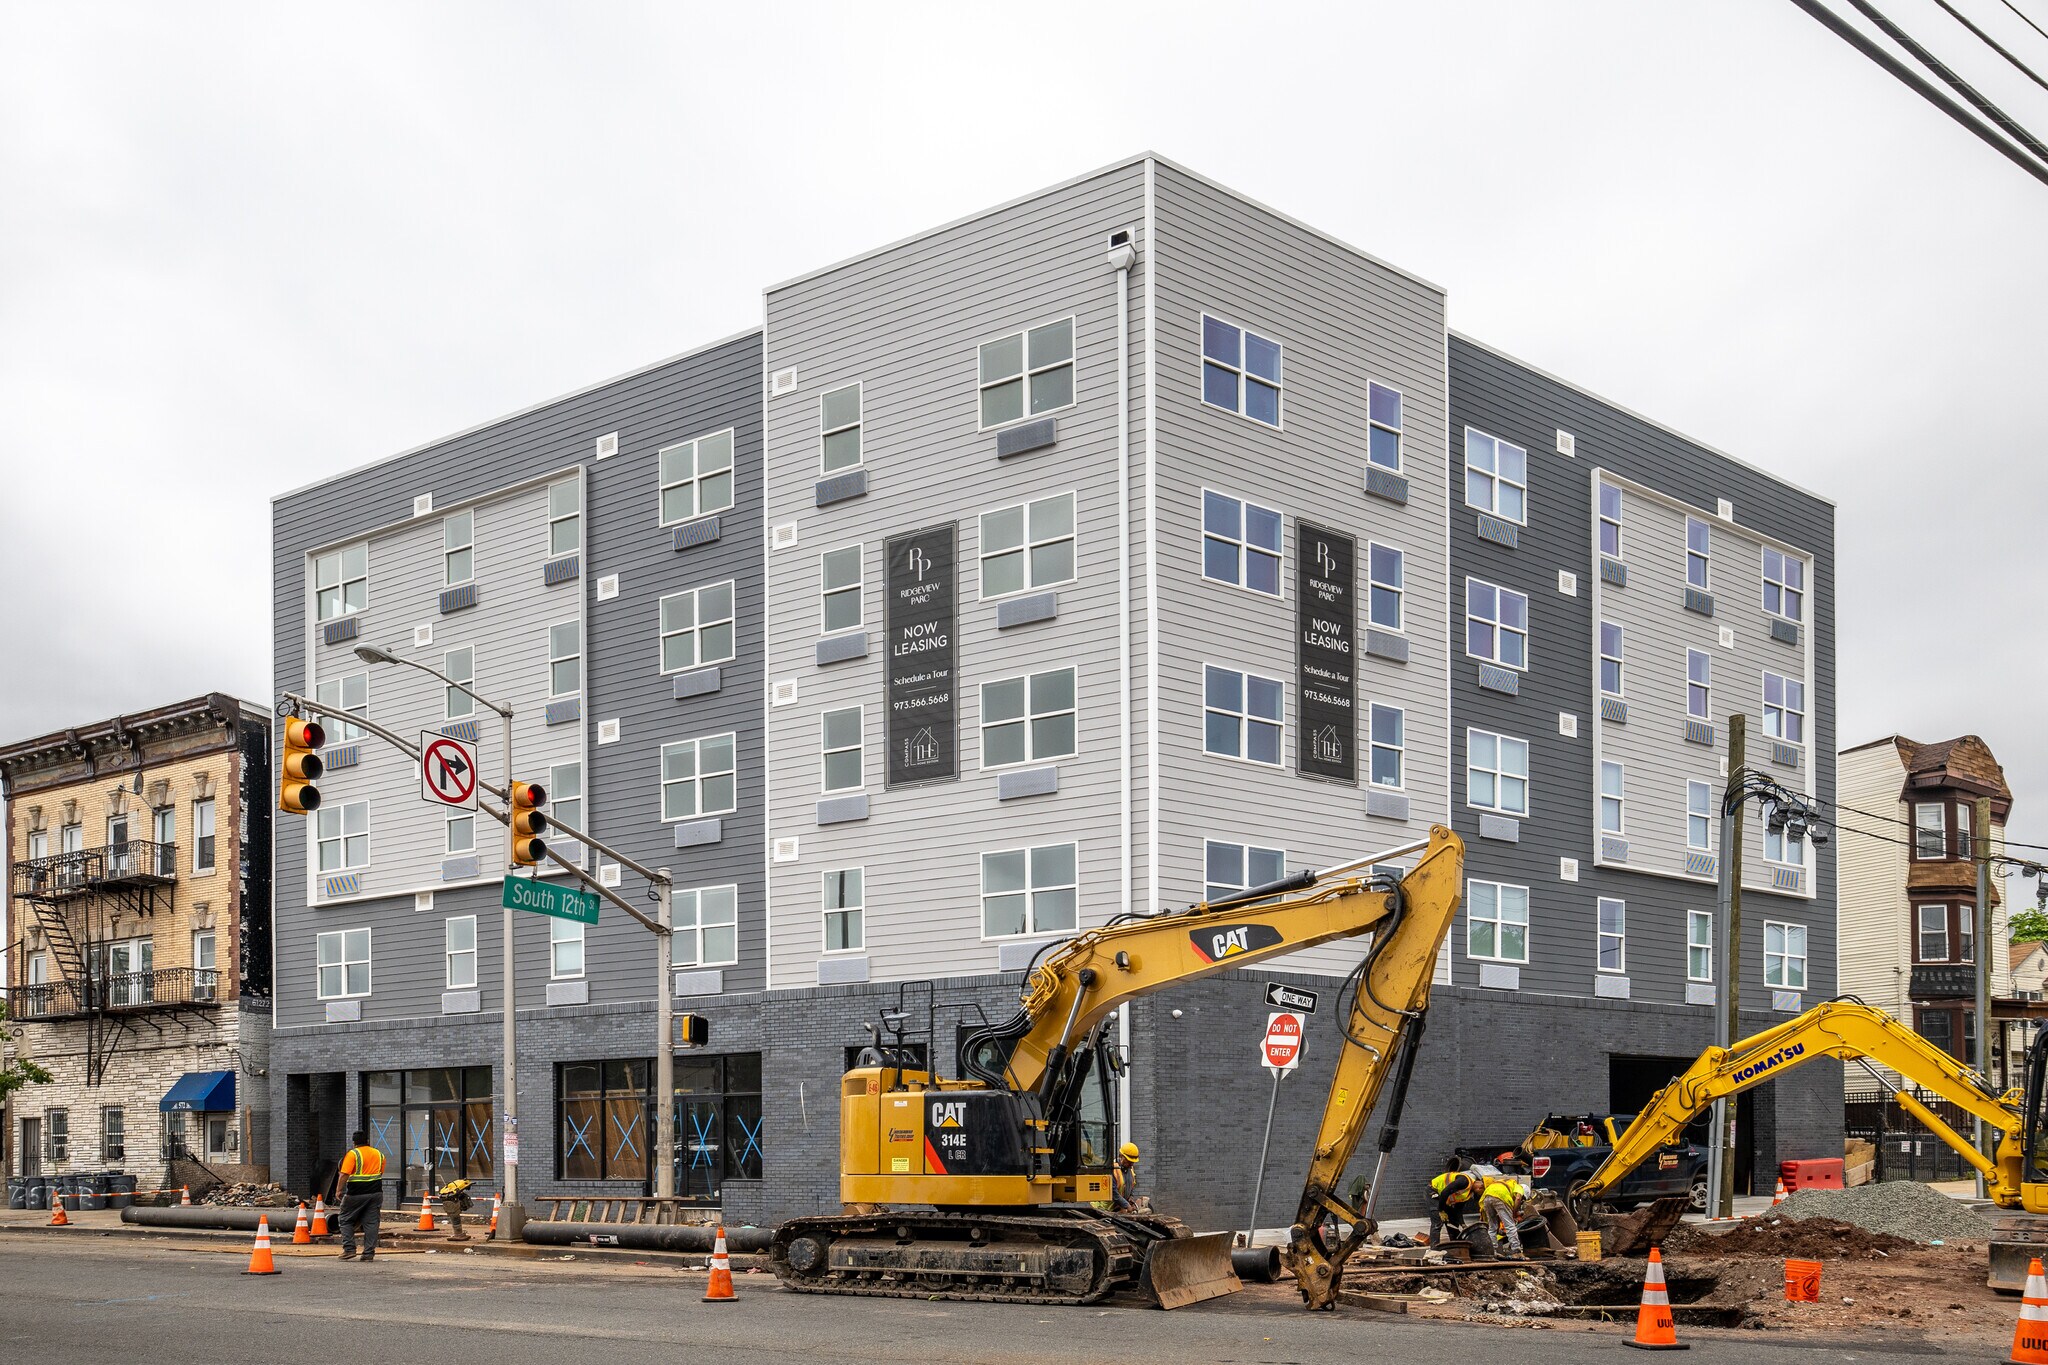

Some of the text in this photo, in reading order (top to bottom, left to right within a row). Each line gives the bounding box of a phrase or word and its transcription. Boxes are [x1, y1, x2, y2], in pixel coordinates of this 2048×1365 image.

[900, 582, 940, 598] RIDGEVIEW
[1309, 579, 1343, 595] RIDGEVIEW
[1318, 590, 1335, 602] PARC
[911, 594, 930, 605] PARC
[904, 621, 938, 639] NOW
[1312, 618, 1341, 636] NOW
[894, 635, 947, 656] LEASING
[1304, 631, 1349, 653] LEASING
[893, 673, 926, 686] Schedule
[932, 670, 949, 679] Tour
[1304, 664, 1331, 679] Schedule
[1336, 672, 1350, 682] Tour
[893, 693, 949, 711] 973.566.5668
[1304, 689, 1351, 708] 973.566.5668
[512, 883, 595, 917] South 12th St
[1212, 926, 1248, 959] CAT
[1281, 992, 1313, 1007] ONE WAY
[1272, 1024, 1298, 1033] DO NOT
[1270, 1047, 1291, 1057] ENTER
[1732, 1042, 1805, 1084] KOMATSU
[932, 1102, 967, 1128] CAT
[941, 1134, 967, 1147] 314E
[948, 1150, 967, 1160] L CR
